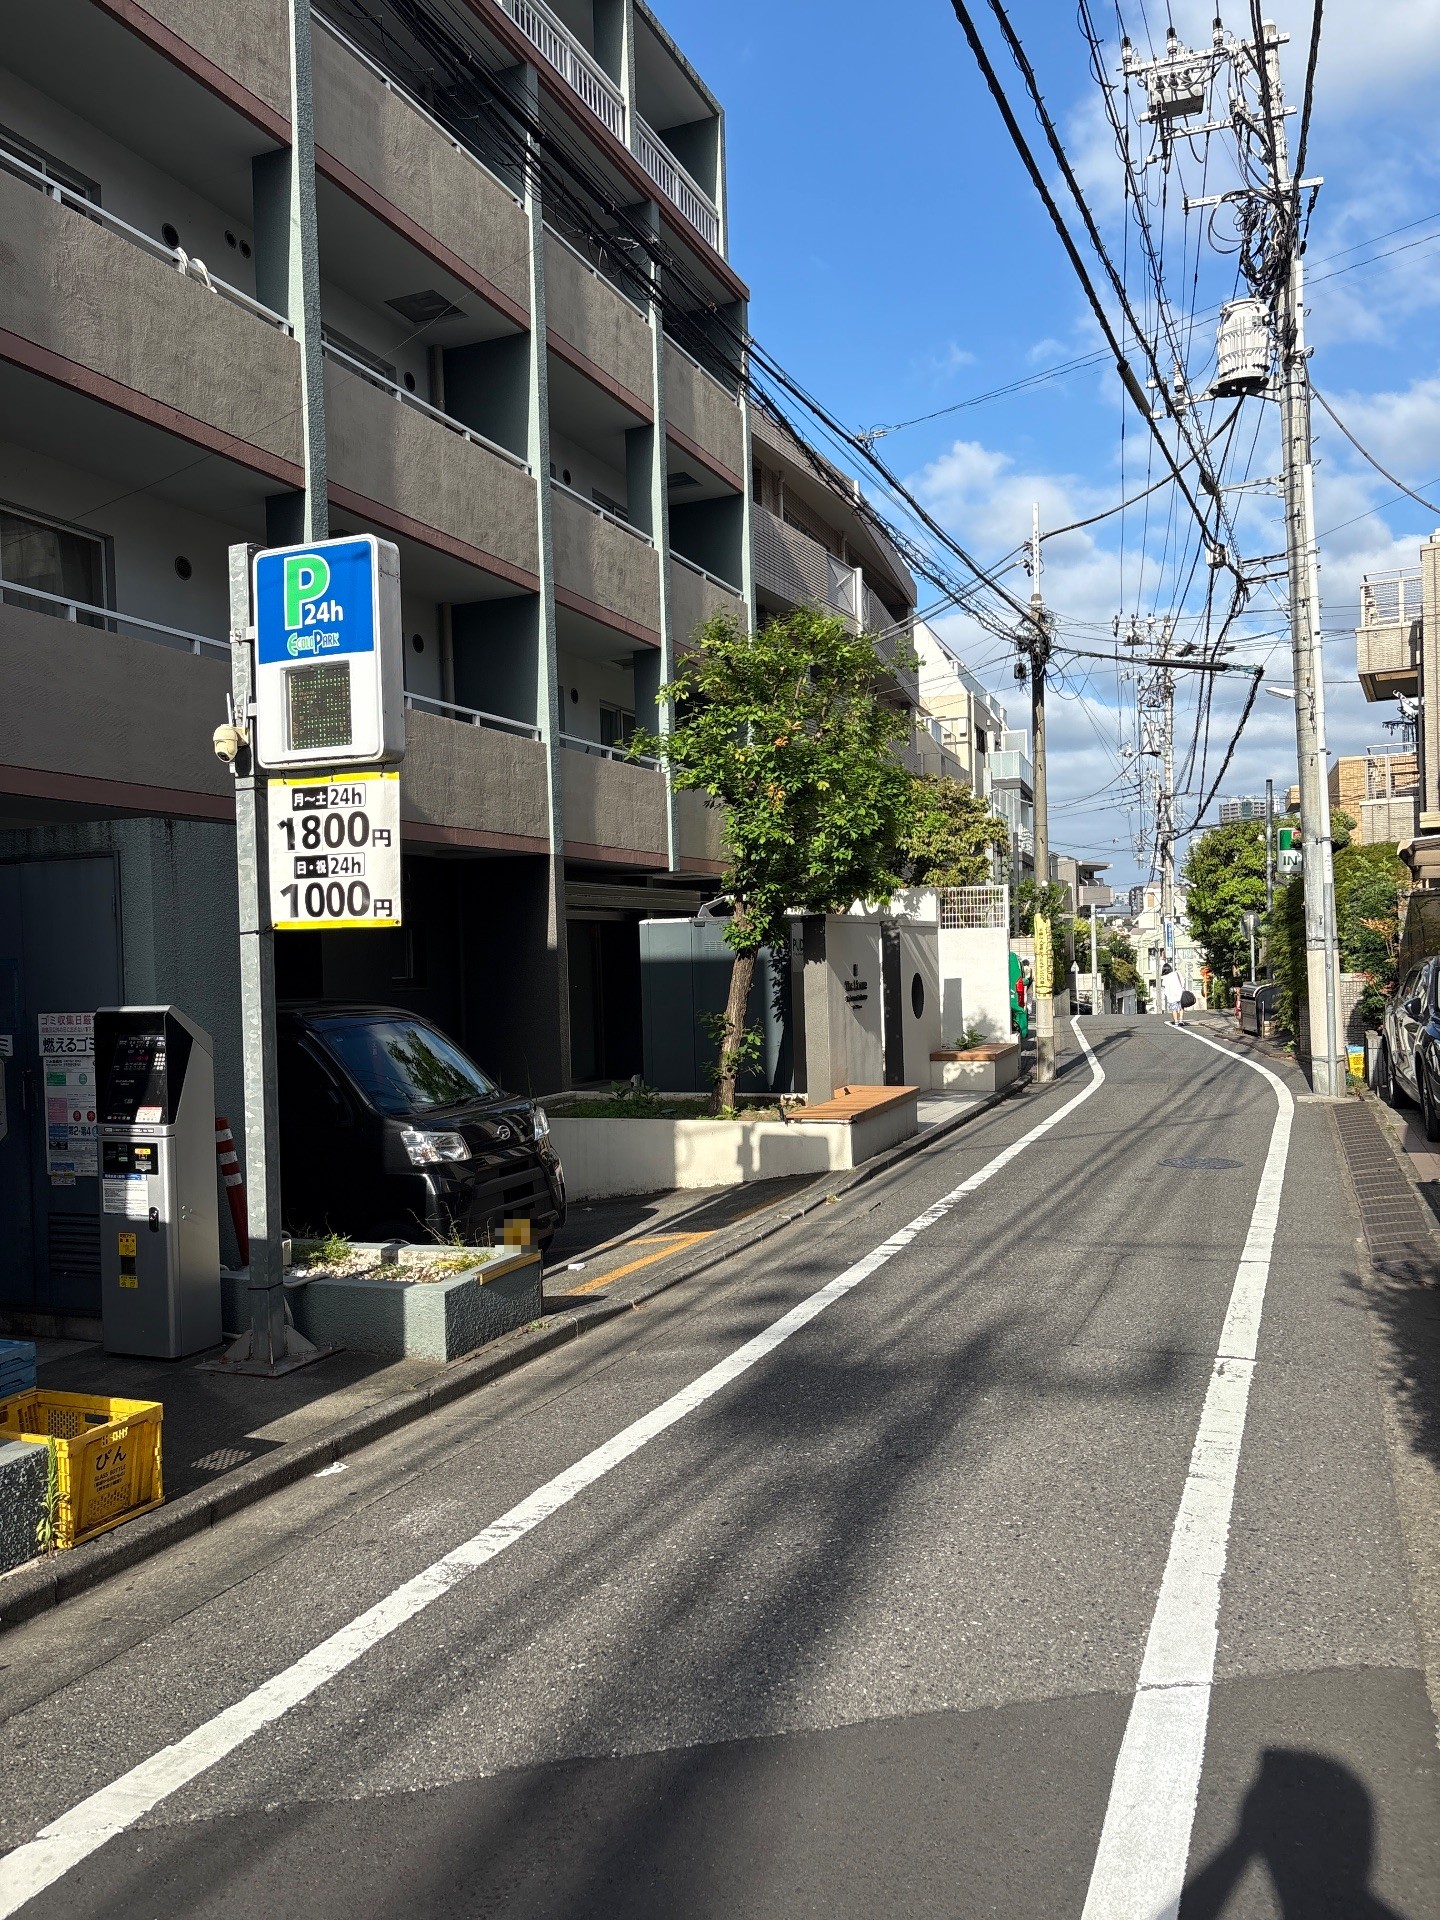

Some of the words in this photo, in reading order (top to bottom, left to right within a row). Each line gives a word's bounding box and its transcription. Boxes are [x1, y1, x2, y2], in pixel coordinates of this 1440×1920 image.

[284, 553, 330, 630] P
[304, 600, 344, 625] 24h
[329, 786, 362, 806] 24h
[276, 810, 392, 851] 1800円
[296, 859, 327, 875] 日・祝
[330, 856, 362, 875] 24h
[1282, 855, 1298, 866] IN
[279, 880, 393, 918] 1000円
[42, 1036, 95, 1053] 燃えるゴミ
[96, 1445, 127, 1471] びん
